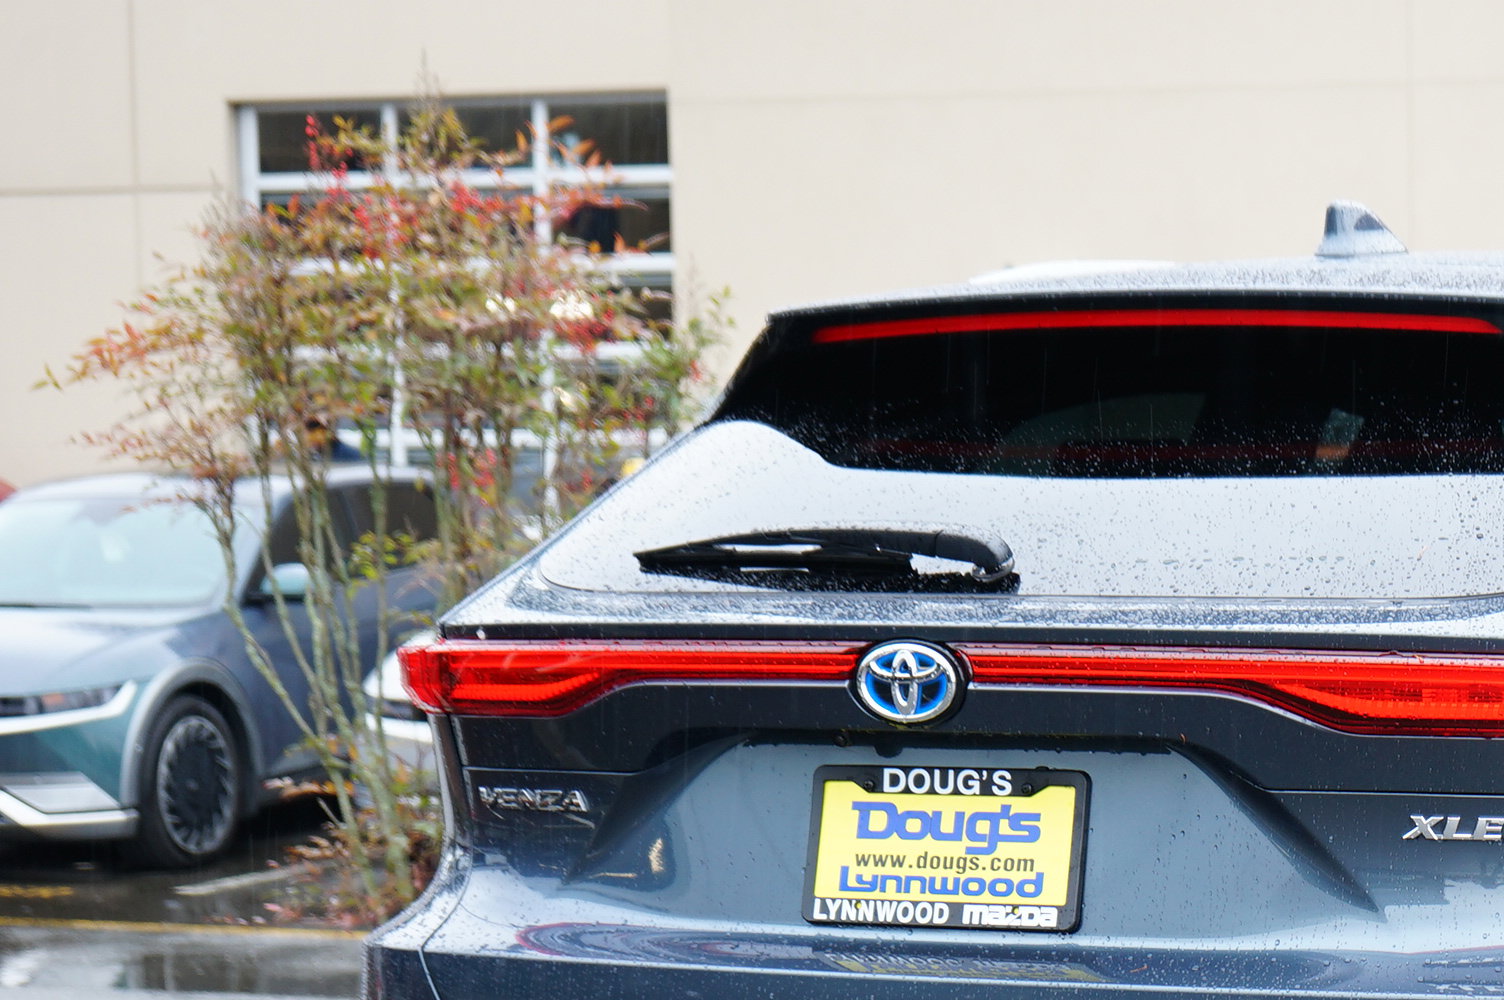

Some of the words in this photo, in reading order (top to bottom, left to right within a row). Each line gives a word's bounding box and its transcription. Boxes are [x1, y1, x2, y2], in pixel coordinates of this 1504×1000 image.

[883, 767, 1013, 796] DOUG'S
[478, 786, 590, 812] VENZA
[852, 801, 1042, 855] Doug's
[855, 851, 1035, 874] www.dougs.com
[839, 865, 1045, 898] Lynnwood
[812, 898, 950, 924] LYNNWOOD
